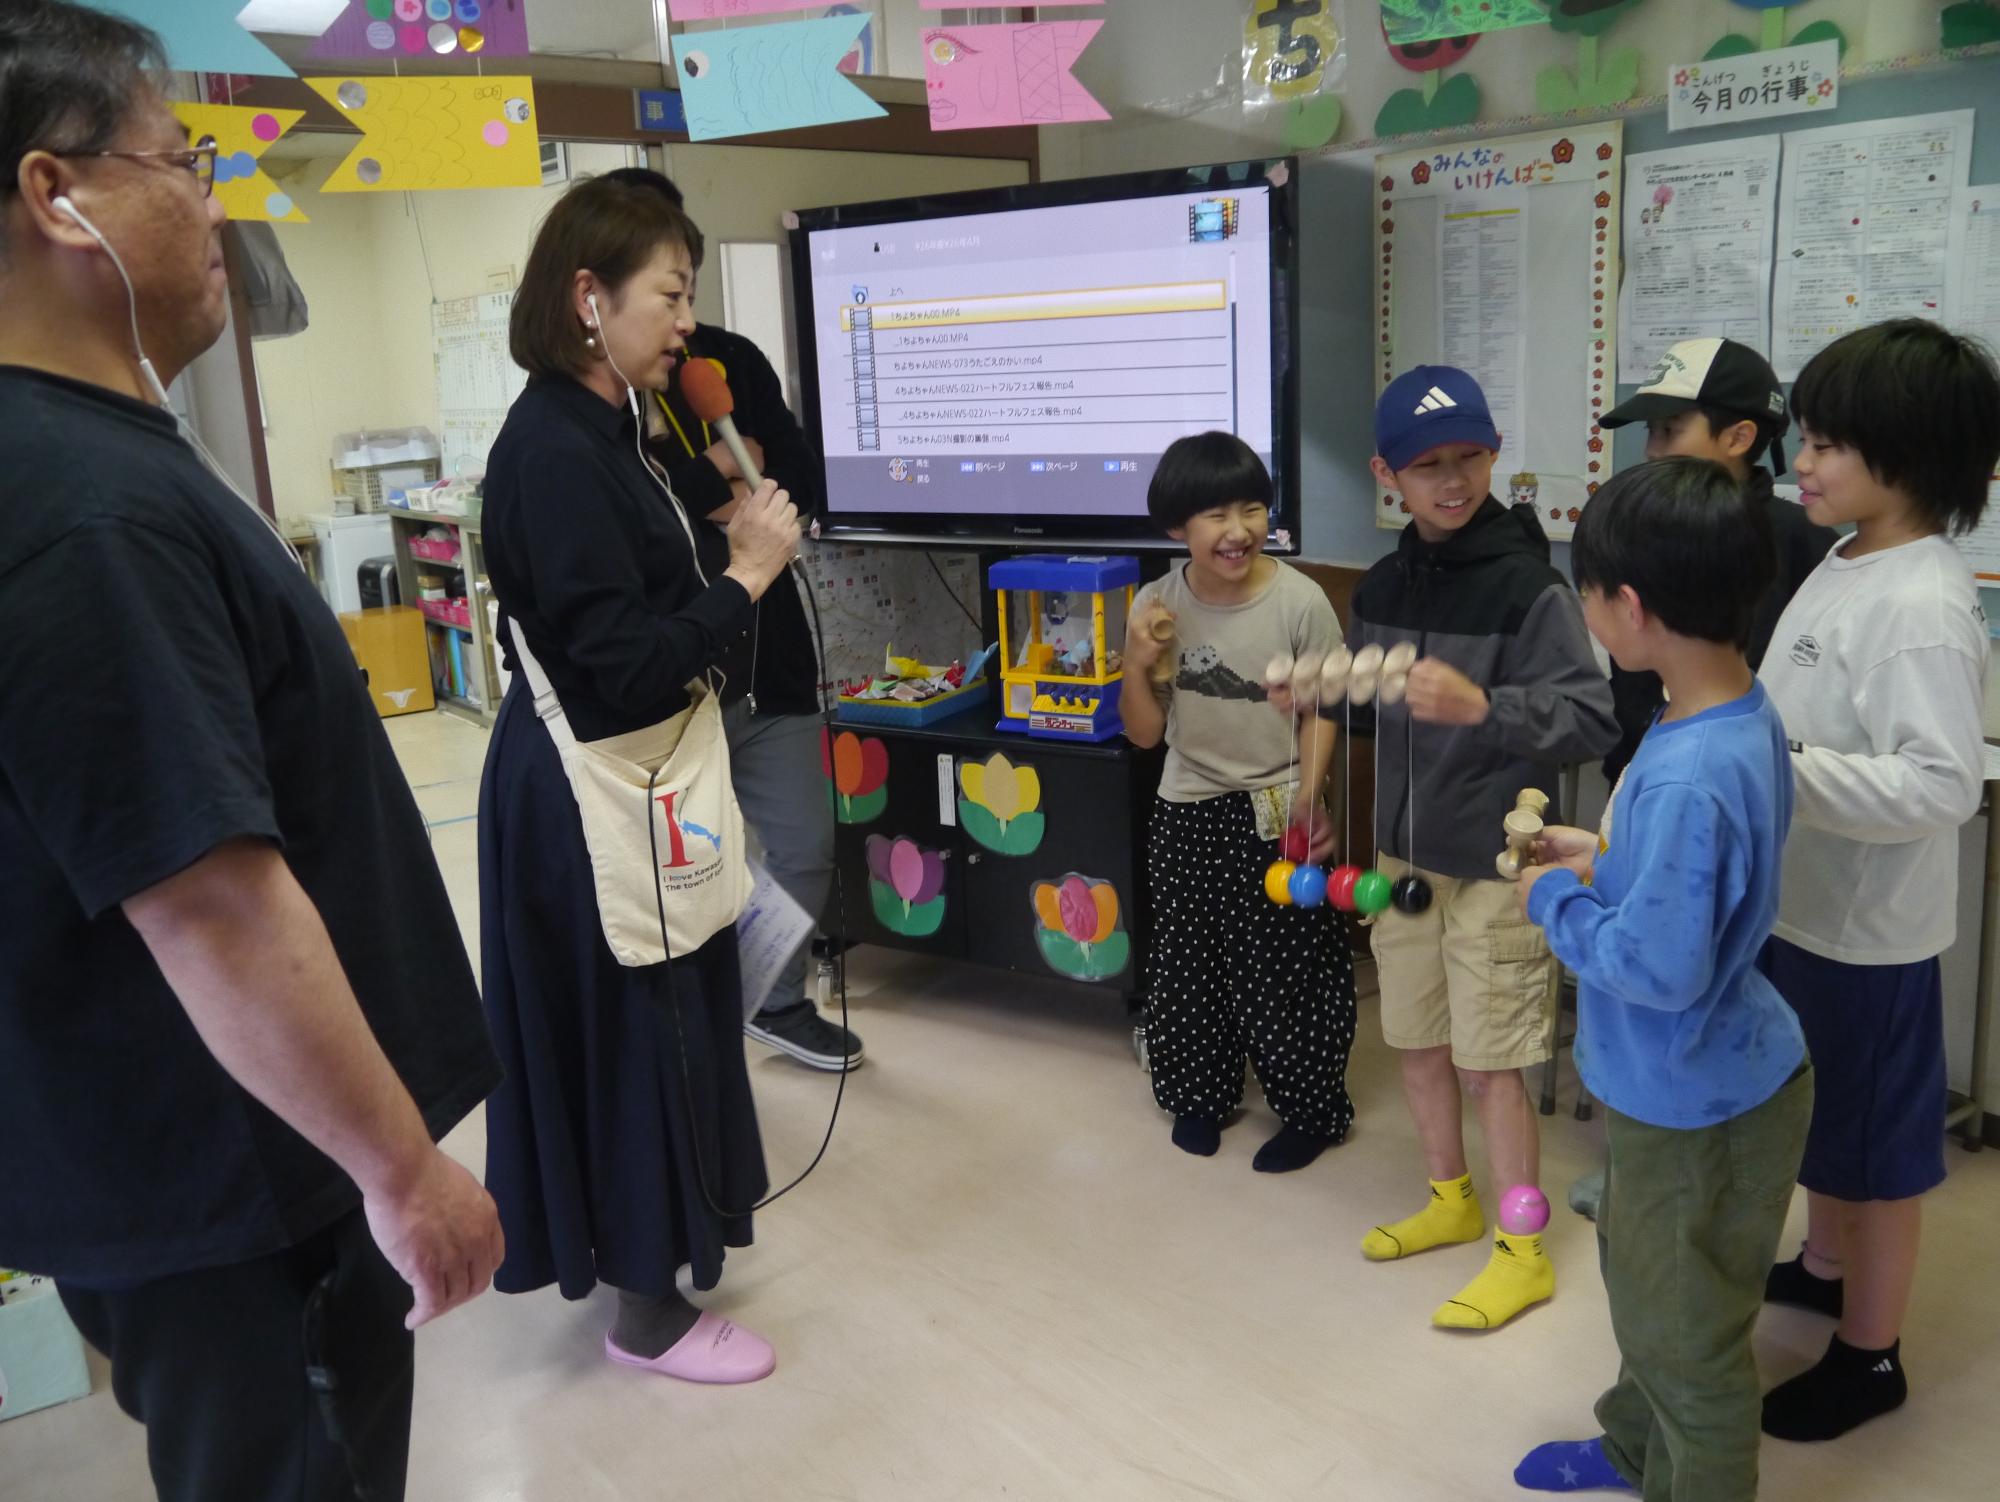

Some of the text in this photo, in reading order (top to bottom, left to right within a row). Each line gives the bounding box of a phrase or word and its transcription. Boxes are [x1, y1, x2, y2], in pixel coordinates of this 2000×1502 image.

[1762, 60, 1809, 78] ぎょうじ
[1691, 72, 1736, 88] こんげつ
[1691, 75, 1808, 114] 今月の行事
[1433, 148, 1504, 172] みんなの
[1455, 158, 1554, 190] いけんばこ
[975, 461, 1006, 473] 前ページ
[1046, 460, 1078, 472] 次ページ
[1120, 460, 1138, 472] 再生
[665, 884, 682, 892] The
[684, 879, 705, 889] town
